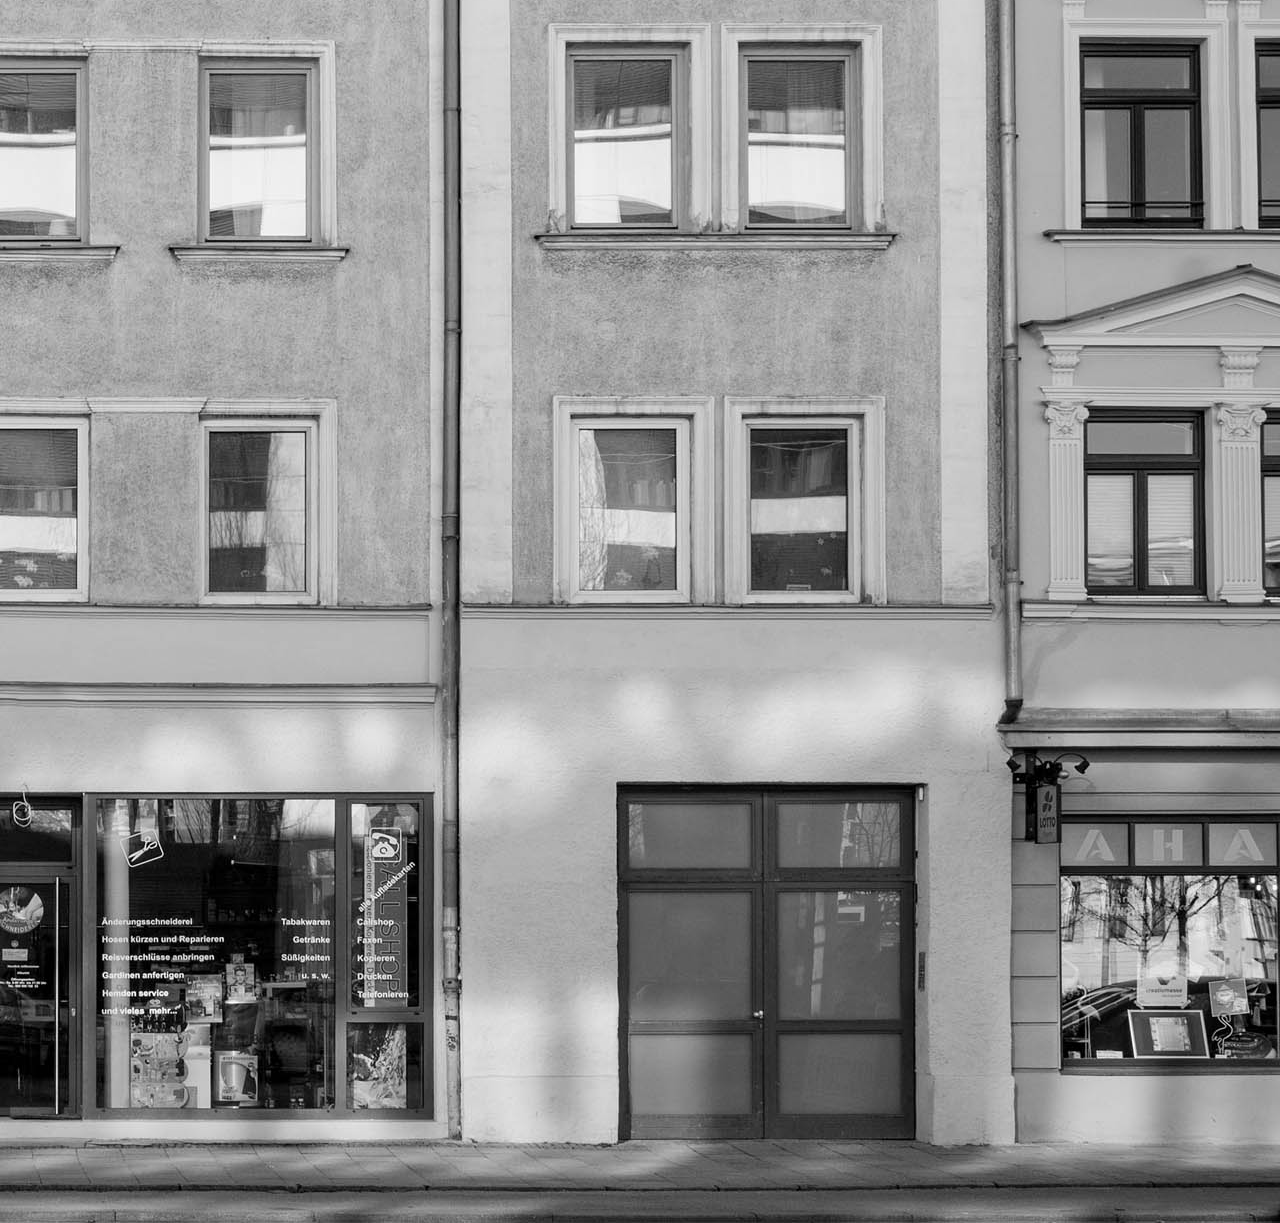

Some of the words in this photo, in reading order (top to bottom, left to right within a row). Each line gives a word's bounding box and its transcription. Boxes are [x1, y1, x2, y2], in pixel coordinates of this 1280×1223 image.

[1039, 817, 1056, 828] LOTTO
[371, 861, 416, 900] Aufladekarten
[101, 917, 193, 927] Änderungsschneiderei
[281, 918, 331, 926] Tabakwaren
[356, 918, 394, 928] Callshop
[130, 935, 159, 943] kürzen
[160, 935, 178, 943] und
[179, 935, 225, 944] Reparieren
[292, 935, 331, 944] Getränke
[356, 936, 383, 944] Faxen
[101, 953, 171, 961] Reisverschlüsse
[172, 953, 215, 962] anbringen
[281, 953, 331, 963] Süßigkeiten
[356, 954, 396, 963] Kopieren
[380, 923, 400, 994] SHOP
[102, 971, 140, 979] Gardinen
[142, 971, 185, 980] anfertigen
[357, 972, 393, 980] Drucken
[102, 989, 137, 997] Hemden
[138, 989, 169, 997] service
[356, 990, 409, 999] Telefonieren
[101, 1007, 118, 1015] und
[119, 1007, 145, 1015] vieles
